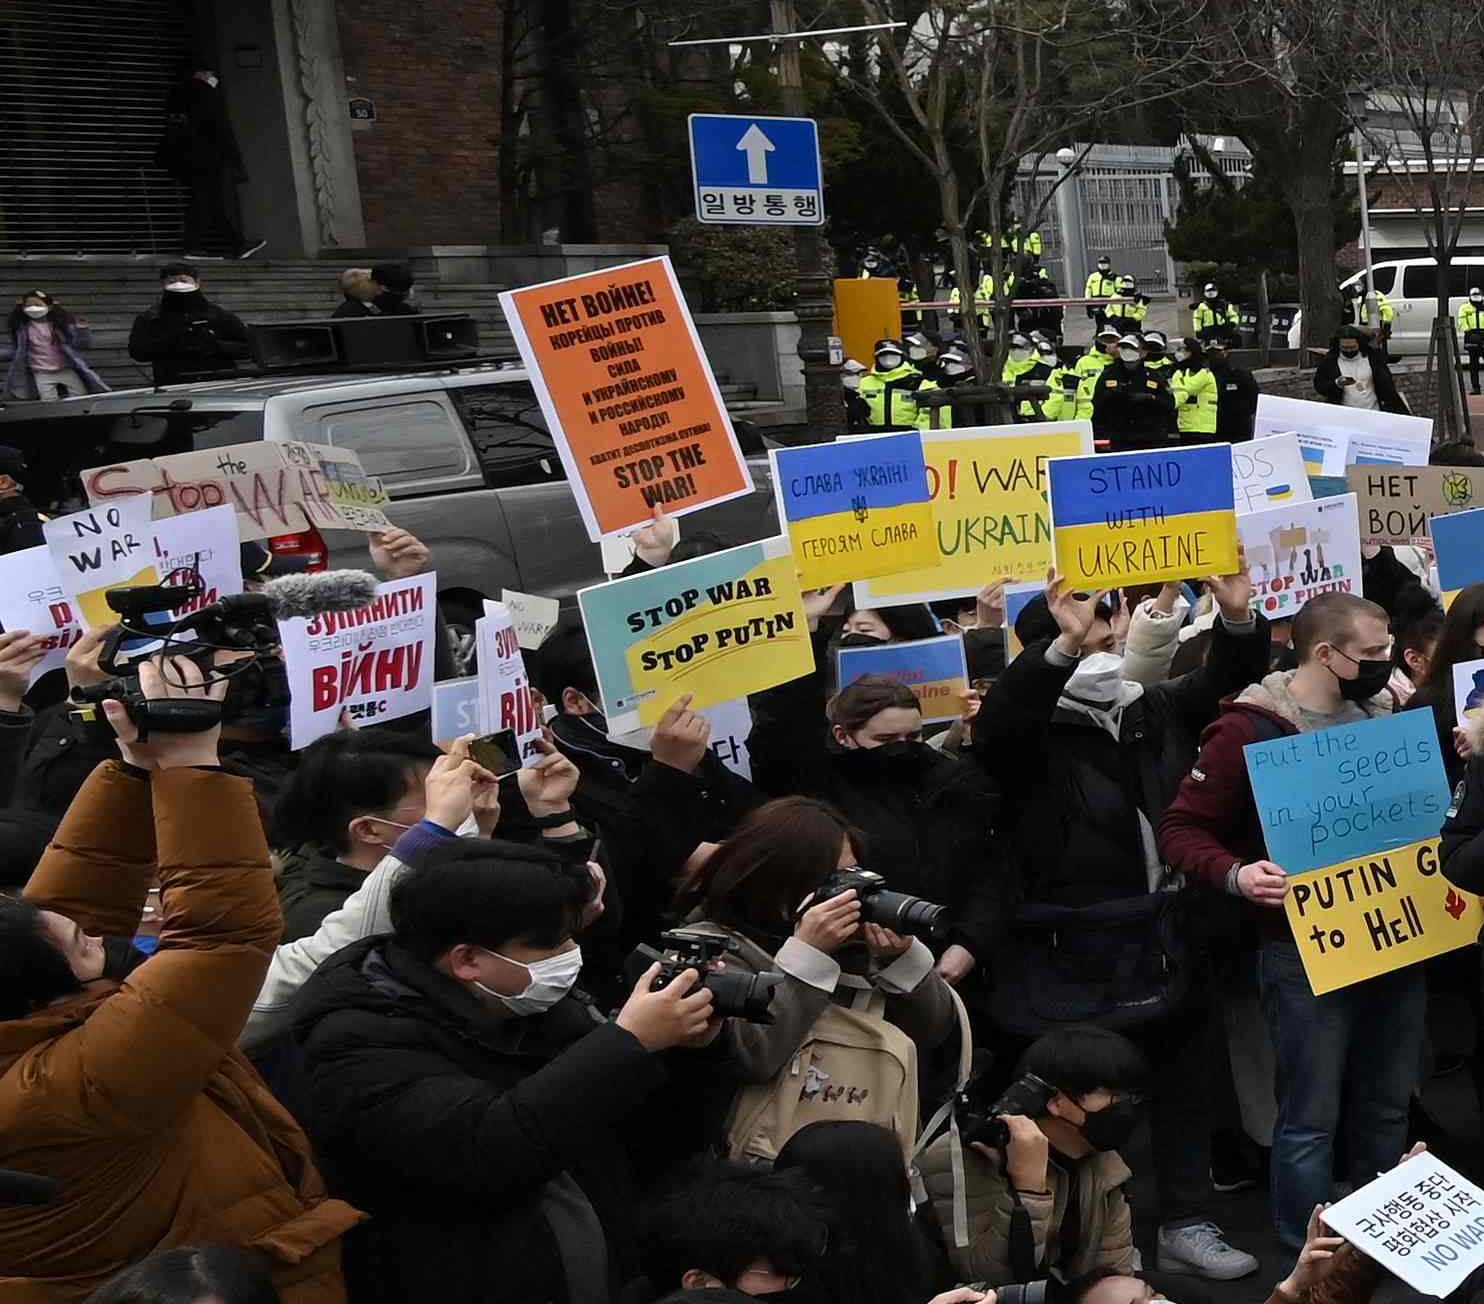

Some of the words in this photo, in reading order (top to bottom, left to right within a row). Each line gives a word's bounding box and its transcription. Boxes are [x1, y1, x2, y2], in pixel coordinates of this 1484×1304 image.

[703, 193, 817, 217] 일방통행
[540, 298, 580, 328] НЕТ
[582, 280, 657, 318] ВОЙНЕ!
[549, 322, 615, 351] КОРЕЙЦЫ
[616, 310, 666, 333] ПРОТИВ
[590, 337, 645, 363] ВОЙНЫ!
[607, 359, 641, 378] СИЛА
[619, 411, 671, 437] НАРОДУ!
[217, 454, 248, 476] the
[614, 455, 666, 489] STOP
[667, 443, 706, 470] THE
[1088, 461, 1182, 495] STAND
[640, 474, 698, 508] WAR!
[792, 469, 843, 498] СЛАВА
[1368, 474, 1419, 498] НЕТ
[73, 507, 121, 538] NO
[1105, 506, 1166, 530] WITH
[69, 533, 142, 573] WAR
[802, 534, 862, 560] ГЕРОЯМ
[871, 524, 918, 548] СЛАВА
[1079, 532, 1212, 578] UKRAINE
[627, 588, 700, 633] STOP
[706, 576, 774, 606] WAR
[641, 636, 709, 673] STOP
[717, 611, 796, 650] PUTIN
[1313, 732, 1357, 757] the
[1338, 741, 1431, 784] seeds
[1269, 806, 1294, 827] in
[1306, 784, 1374, 826] your
[1311, 795, 1440, 857] pockets
[1293, 858, 1397, 917] PUTIN
[1310, 924, 1345, 954] to
[1355, 1190, 1425, 1240] 군사행동
[1414, 1171, 1457, 1201] 중단
[1381, 1208, 1451, 1258] 평화협상
[1443, 1190, 1483, 1217] 시작
[1420, 1243, 1459, 1272] NO
